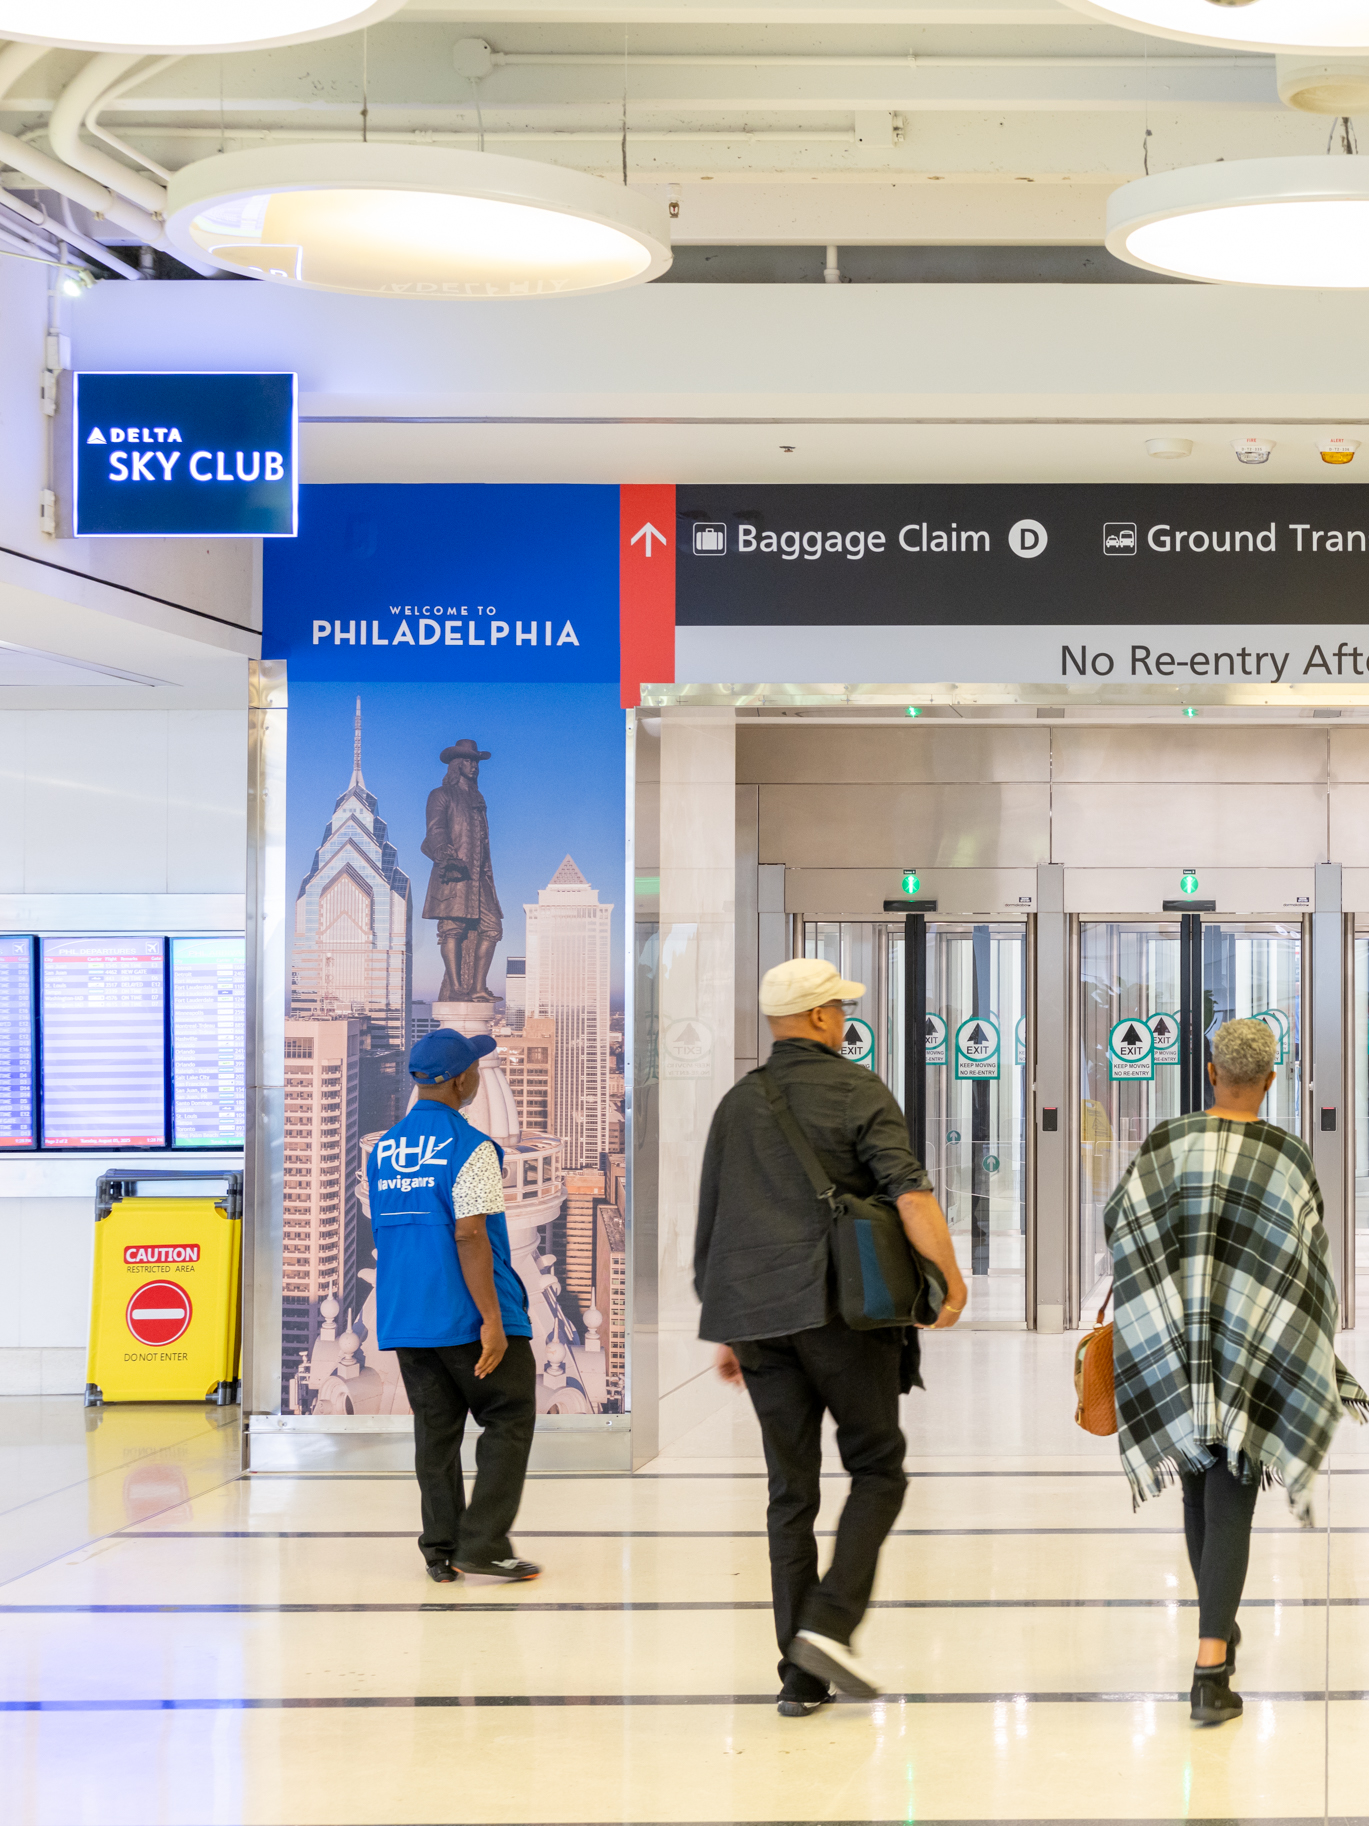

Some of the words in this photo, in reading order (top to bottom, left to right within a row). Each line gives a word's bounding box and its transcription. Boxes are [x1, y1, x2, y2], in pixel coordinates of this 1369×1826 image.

[110, 427, 183, 443] DELTA
[108, 450, 181, 483] SKY
[189, 450, 285, 483] CLUB
[738, 523, 887, 560] Baggage
[897, 522, 991, 553] Claim
[1020, 526, 1047, 553] D
[1147, 522, 1276, 553] Ground
[389, 605, 470, 616] WELCOME
[477, 606, 497, 616] TO
[312, 618, 581, 646] PHILADELPHIA
[1061, 645, 1115, 676] No
[1131, 643, 1290, 683] Re-entry
[925, 1036, 939, 1044] XIT
[841, 1046, 864, 1055] EXIT
[966, 1046, 990, 1055] EXIT
[1120, 1047, 1143, 1056] EXIT
[377, 1135, 450, 1171] PHL
[125, 1247, 198, 1263] CAUTION
[126, 1265, 171, 1273] RESTRICTED
[174, 1265, 196, 1273] AREA
[123, 1353, 138, 1362] DO
[138, 1352, 158, 1362] NOT
[160, 1352, 189, 1362] ENTER
